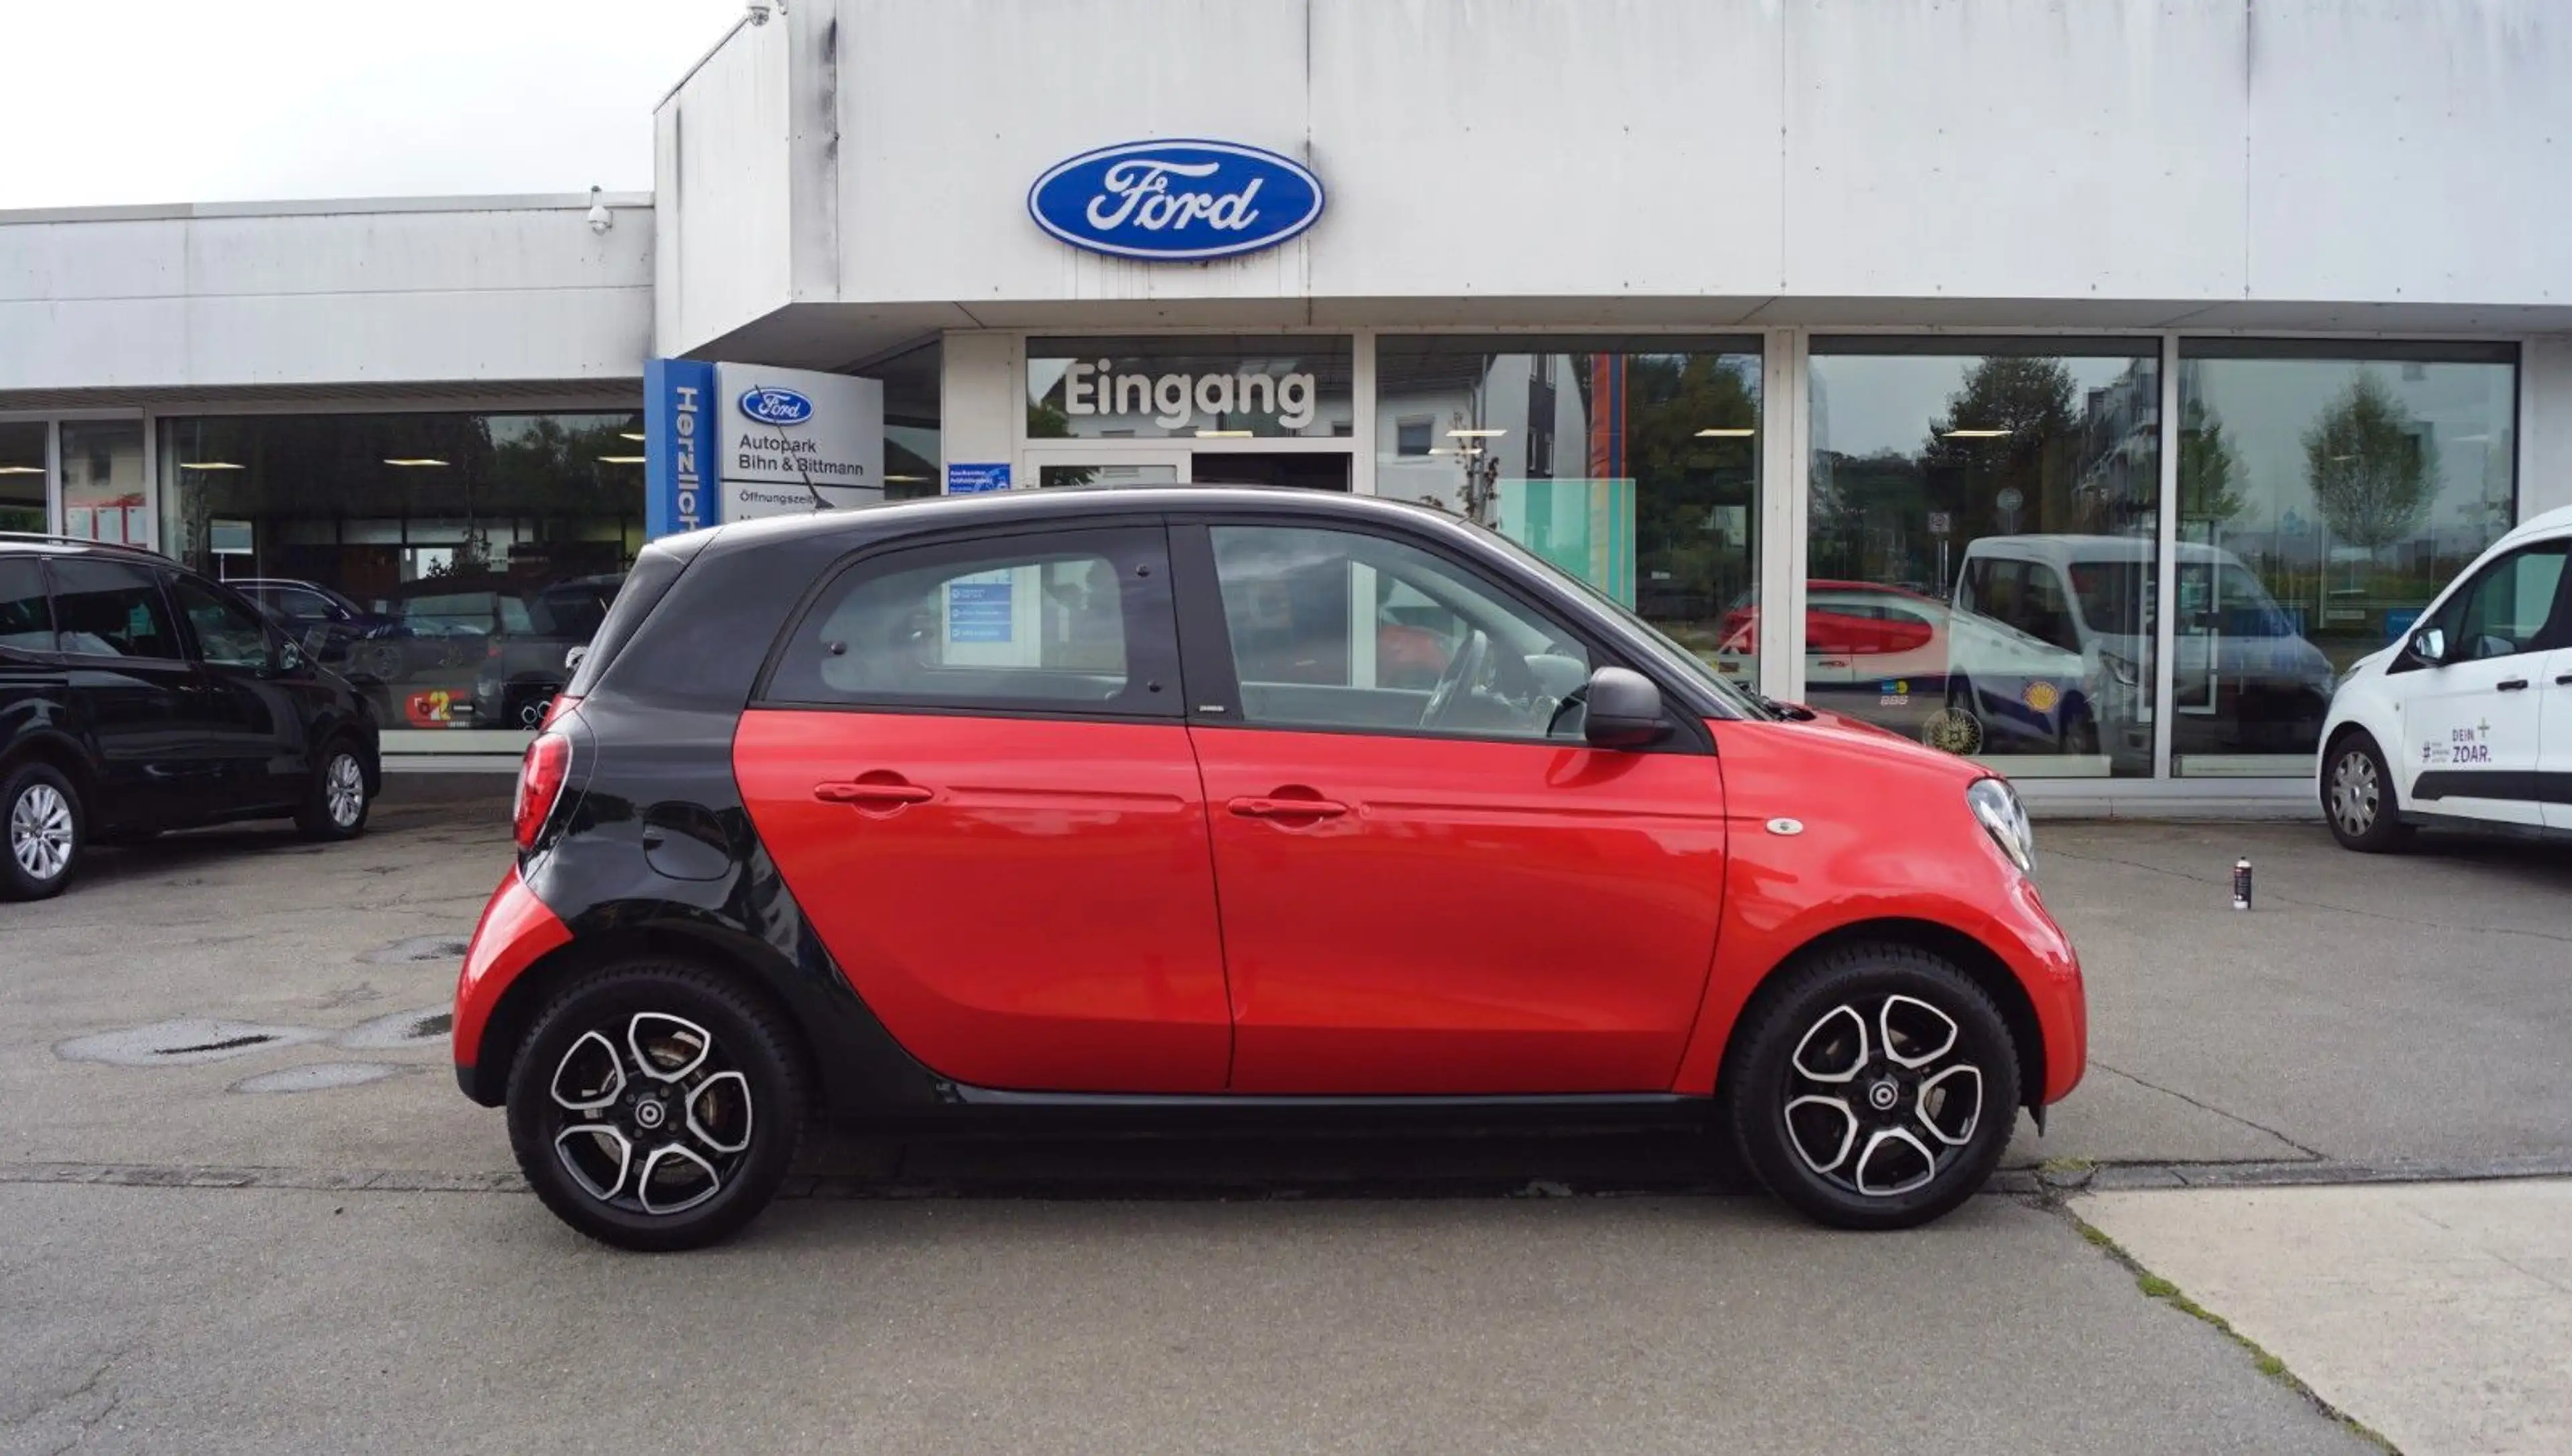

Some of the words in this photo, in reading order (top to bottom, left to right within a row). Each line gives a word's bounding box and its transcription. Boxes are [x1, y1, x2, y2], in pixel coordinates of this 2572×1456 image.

[1086, 160, 1263, 230] Ford
[1065, 358, 1315, 429] Eingang
[758, 393, 802, 418] Ford
[739, 434, 816, 454] Autopark
[676, 386, 700, 534] Herzlich
[739, 455, 778, 471] Bihn
[782, 458, 793, 471] &
[797, 458, 864, 476] Bittmann
[739, 489, 816, 506] Öffnungszeit
[2452, 729, 2474, 741] DEIN
